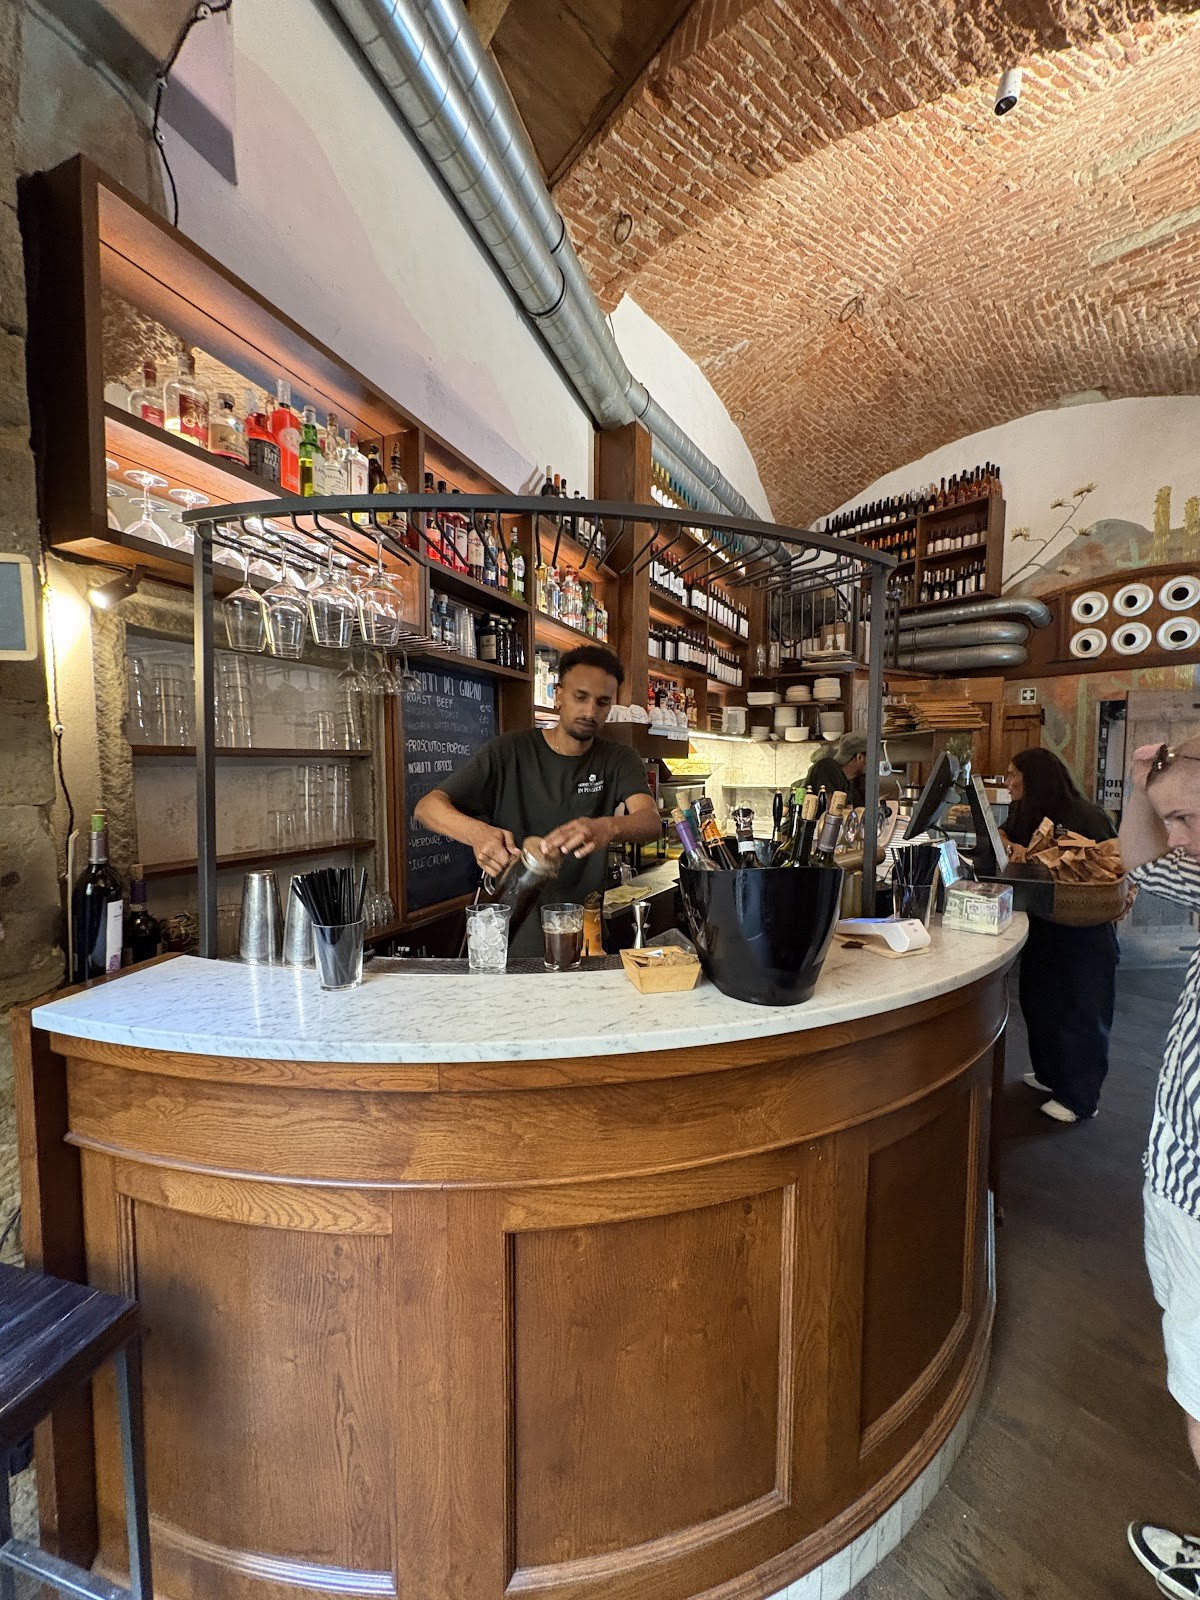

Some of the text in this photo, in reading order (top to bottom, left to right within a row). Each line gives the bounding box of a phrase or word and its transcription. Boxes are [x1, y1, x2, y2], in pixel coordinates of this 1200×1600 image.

[443, 675, 455, 696] DEL
[459, 679, 482, 701] GIORNO
[406, 692, 432, 705] ROAST
[436, 695, 454, 709] BEEF
